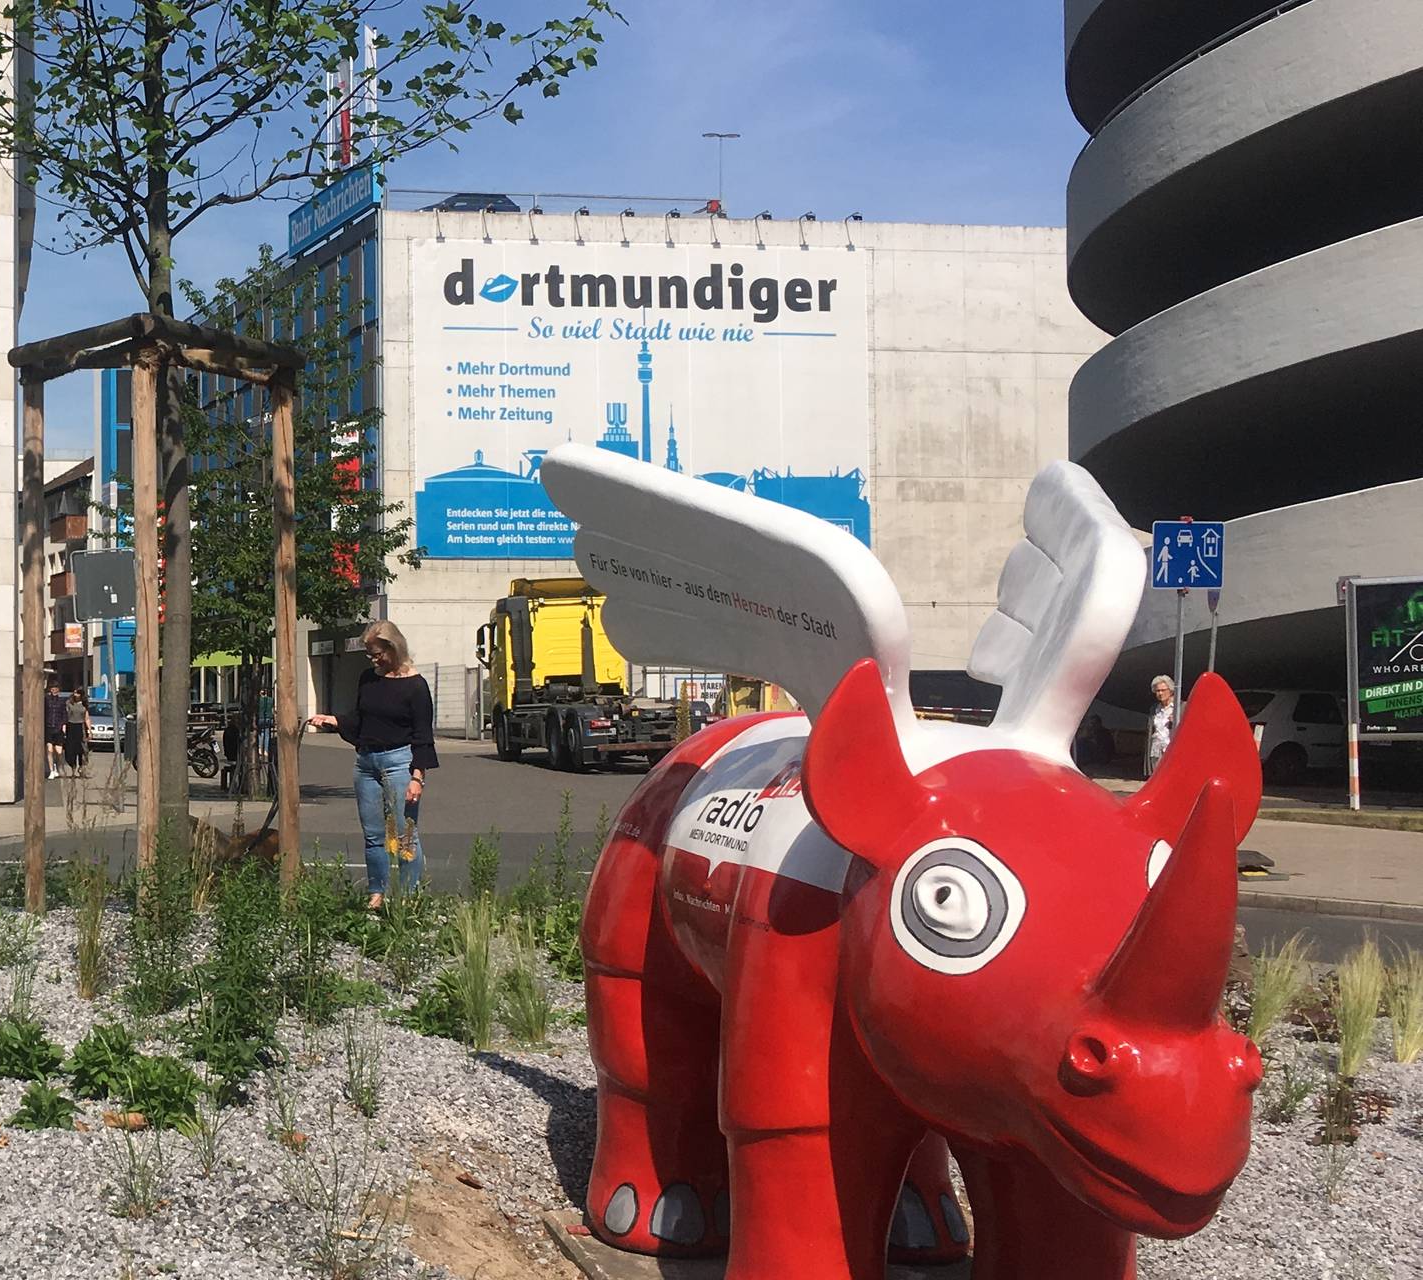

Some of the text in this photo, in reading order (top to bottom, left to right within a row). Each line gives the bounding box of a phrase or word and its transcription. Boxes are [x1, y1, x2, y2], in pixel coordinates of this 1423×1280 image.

[291, 174, 371, 246] Ruhr Nachrichten
[528, 315, 755, 342] So viel Stadt wie nie
[457, 361, 571, 376] Mehr Dortmund
[457, 384, 556, 398] Mehr Themen
[458, 407, 553, 424] Mehr Zeitung
[446, 508, 567, 519] Entdecken Sie jetzt die neu
[446, 521, 475, 531] Serien
[477, 521, 499, 531] rund
[500, 523, 515, 531] um
[517, 521, 535, 531] Ihre
[536, 521, 569, 531] direkte
[447, 534, 463, 544] Am
[464, 534, 495, 544] besten
[496, 534, 524, 546] gleich
[525, 534, 556, 544] testen:
[589, 552, 608, 571] Für
[611, 558, 628, 577] Sie
[629, 567, 649, 583] von
[650, 568, 672, 589] hier
[684, 581, 705, 599] aus
[707, 584, 732, 606] dem
[731, 591, 777, 621] Herzen
[777, 606, 798, 627] der
[801, 611, 838, 640] Stadt
[1371, 629, 1404, 648] FIT
[1372, 664, 1400, 674] WHO
[1365, 683, 1401, 699] DIREKT
[1402, 682, 1413, 692] IN
[697, 791, 764, 833] radio
[689, 828, 748, 852] MEIN DORTMUND
